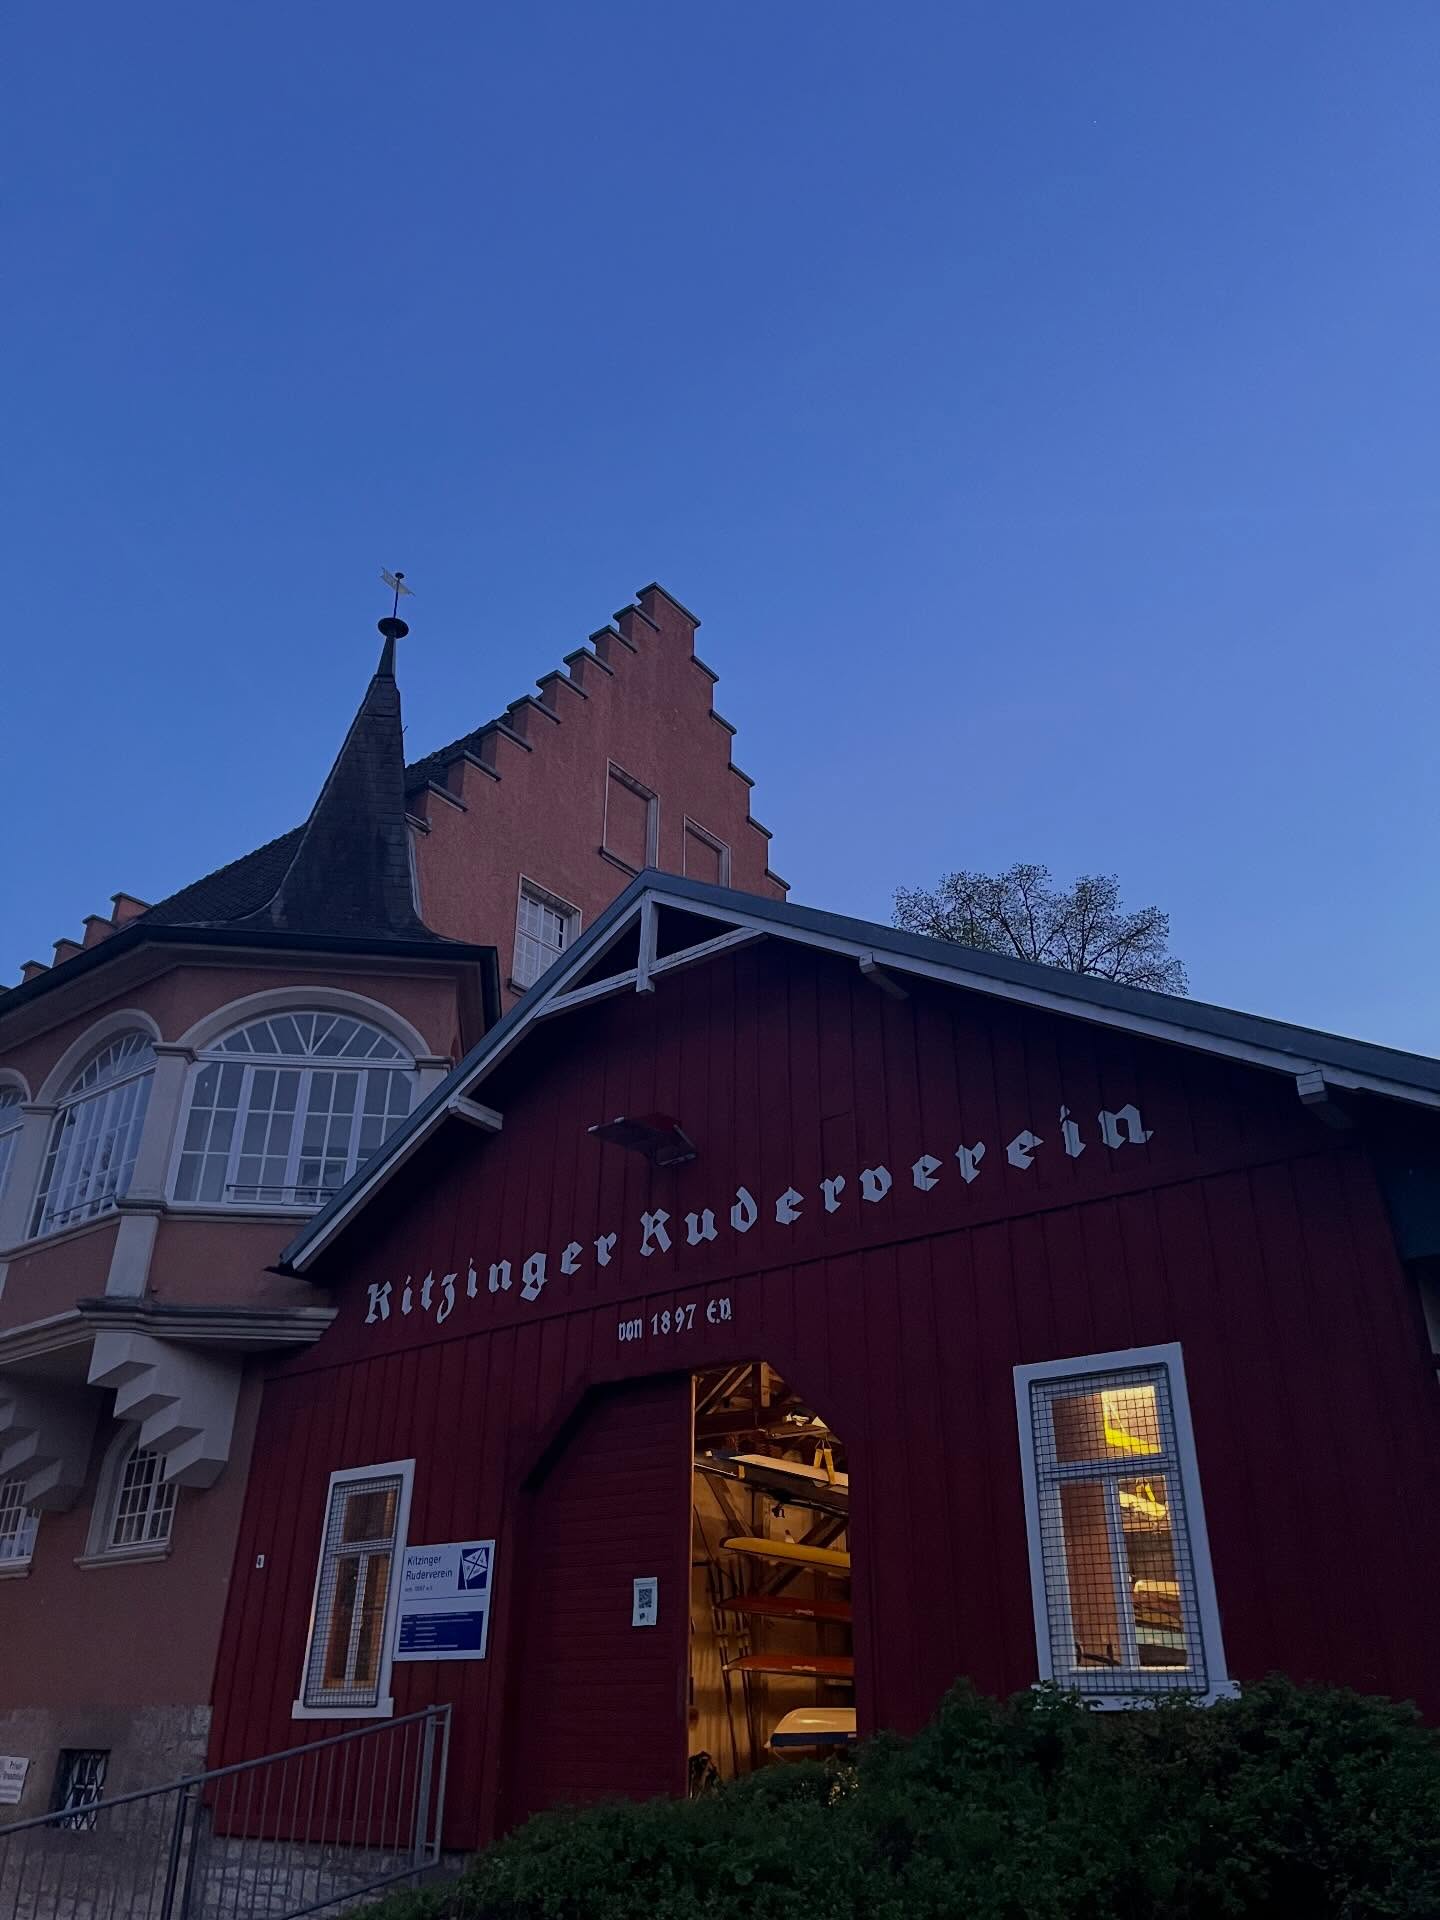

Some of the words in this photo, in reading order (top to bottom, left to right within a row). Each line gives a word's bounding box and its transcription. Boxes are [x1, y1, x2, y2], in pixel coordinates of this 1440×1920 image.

[364, 1233, 617, 1324] Kitzinger
[640, 1103, 1153, 1256] Ruderverein
[618, 1318, 643, 1342] von
[651, 1304, 697, 1335] 1897
[408, 1555, 442, 1566] Kitzinger
[405, 1569, 453, 1580] Ruderverein
